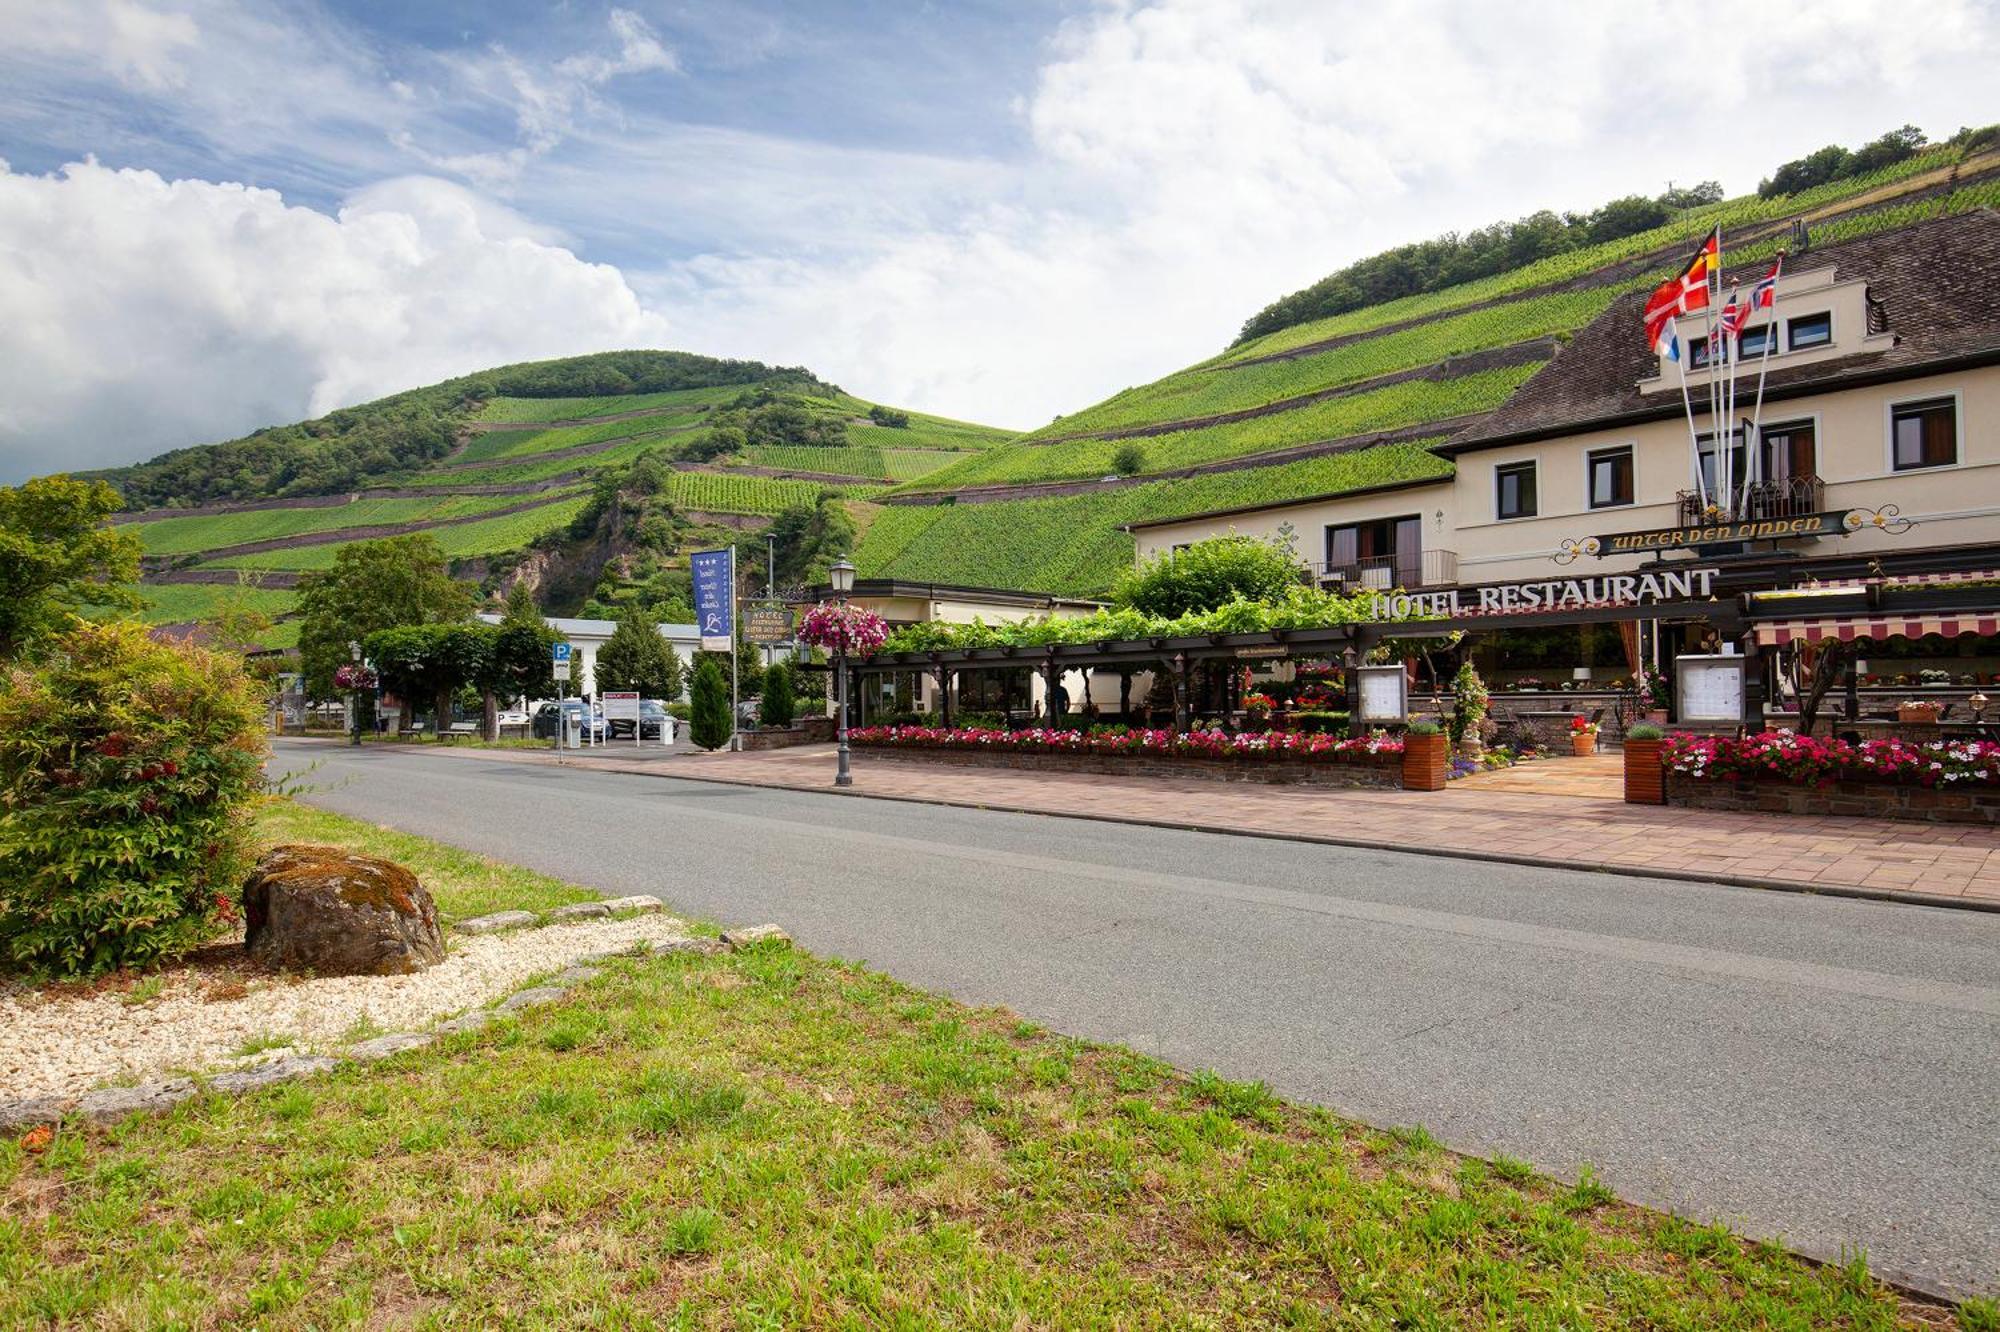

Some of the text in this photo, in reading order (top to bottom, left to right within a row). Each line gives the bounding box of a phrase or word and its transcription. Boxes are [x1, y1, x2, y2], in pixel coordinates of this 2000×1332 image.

[1372, 568, 1720, 621] HOTEL RESTAURANT
[556, 646, 566, 658] P
[498, 714, 505, 723] P
